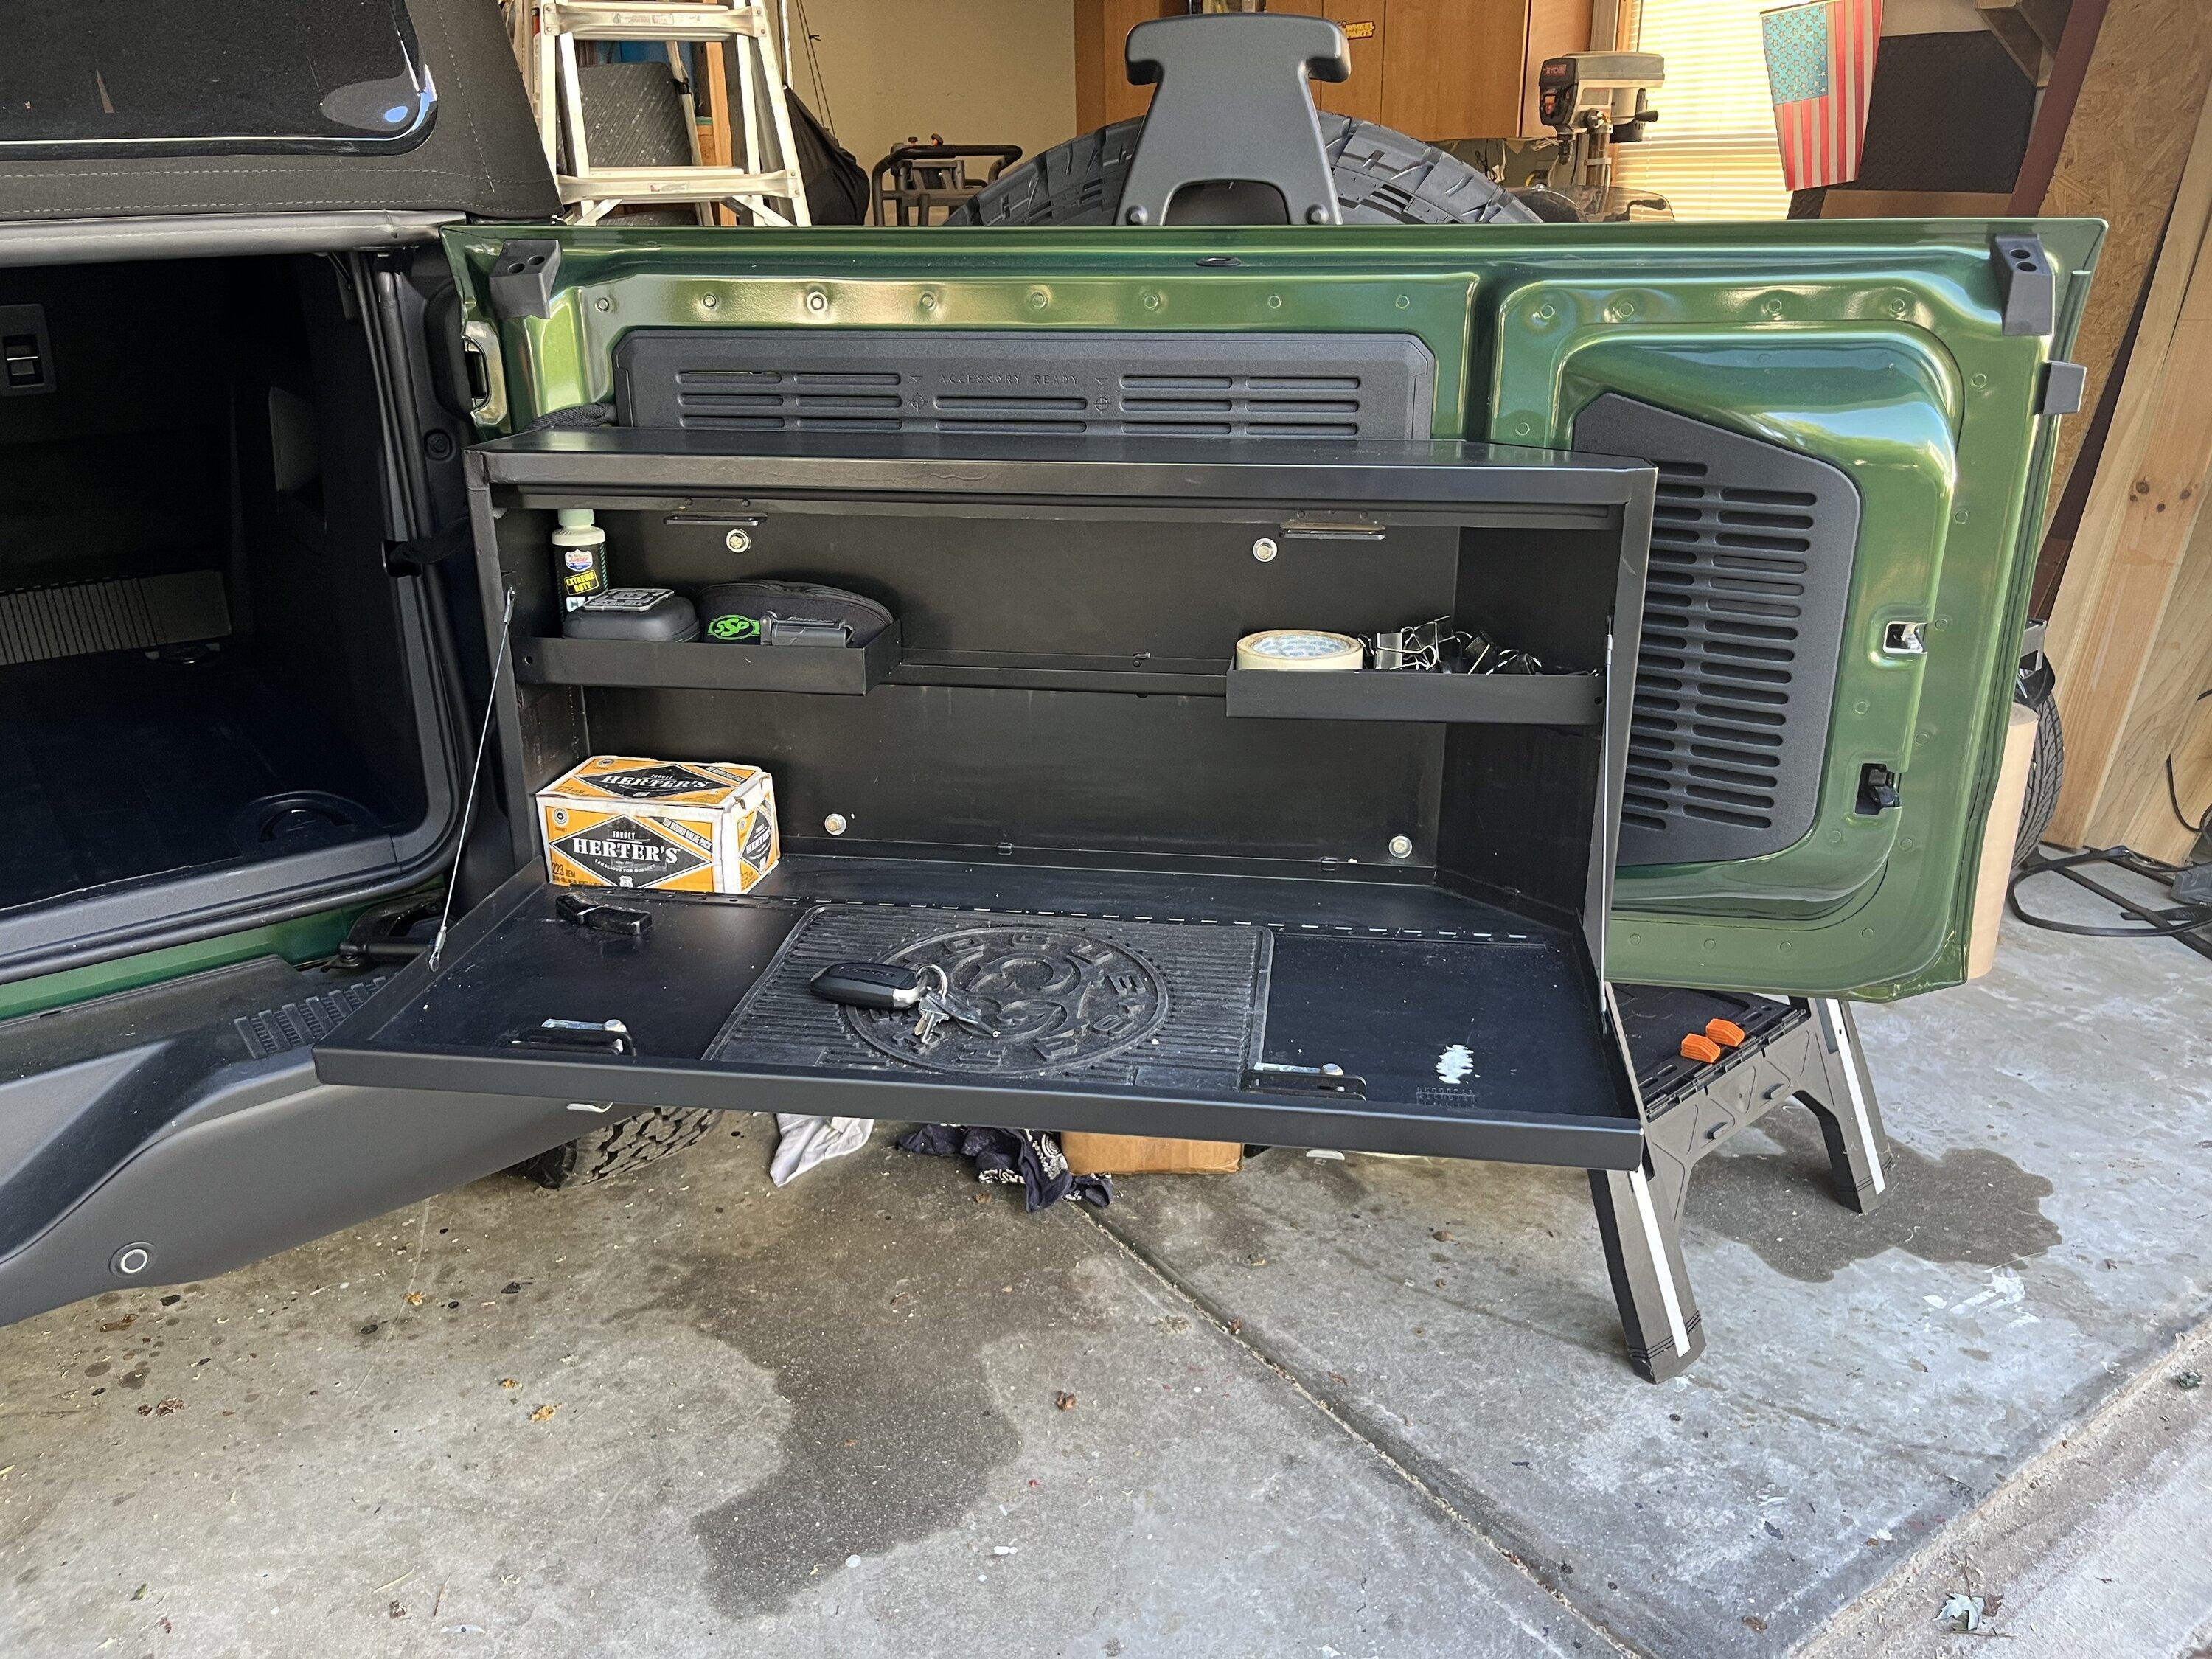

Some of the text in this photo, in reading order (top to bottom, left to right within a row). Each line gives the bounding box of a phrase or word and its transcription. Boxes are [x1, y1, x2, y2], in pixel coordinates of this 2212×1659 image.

[939, 373, 1079, 386] ACCESSORY READY
[566, 571, 596, 586] EXTREME
[574, 581, 592, 593] DUTY
[714, 617, 750, 636] SSP
[600, 775, 708, 788] HERTER'S
[612, 830, 636, 840] TARGET
[685, 830, 700, 844] VALUE
[698, 838, 712, 850] PACK
[572, 837, 678, 863] HERTER'S
[634, 863, 655, 873] QUALITY
